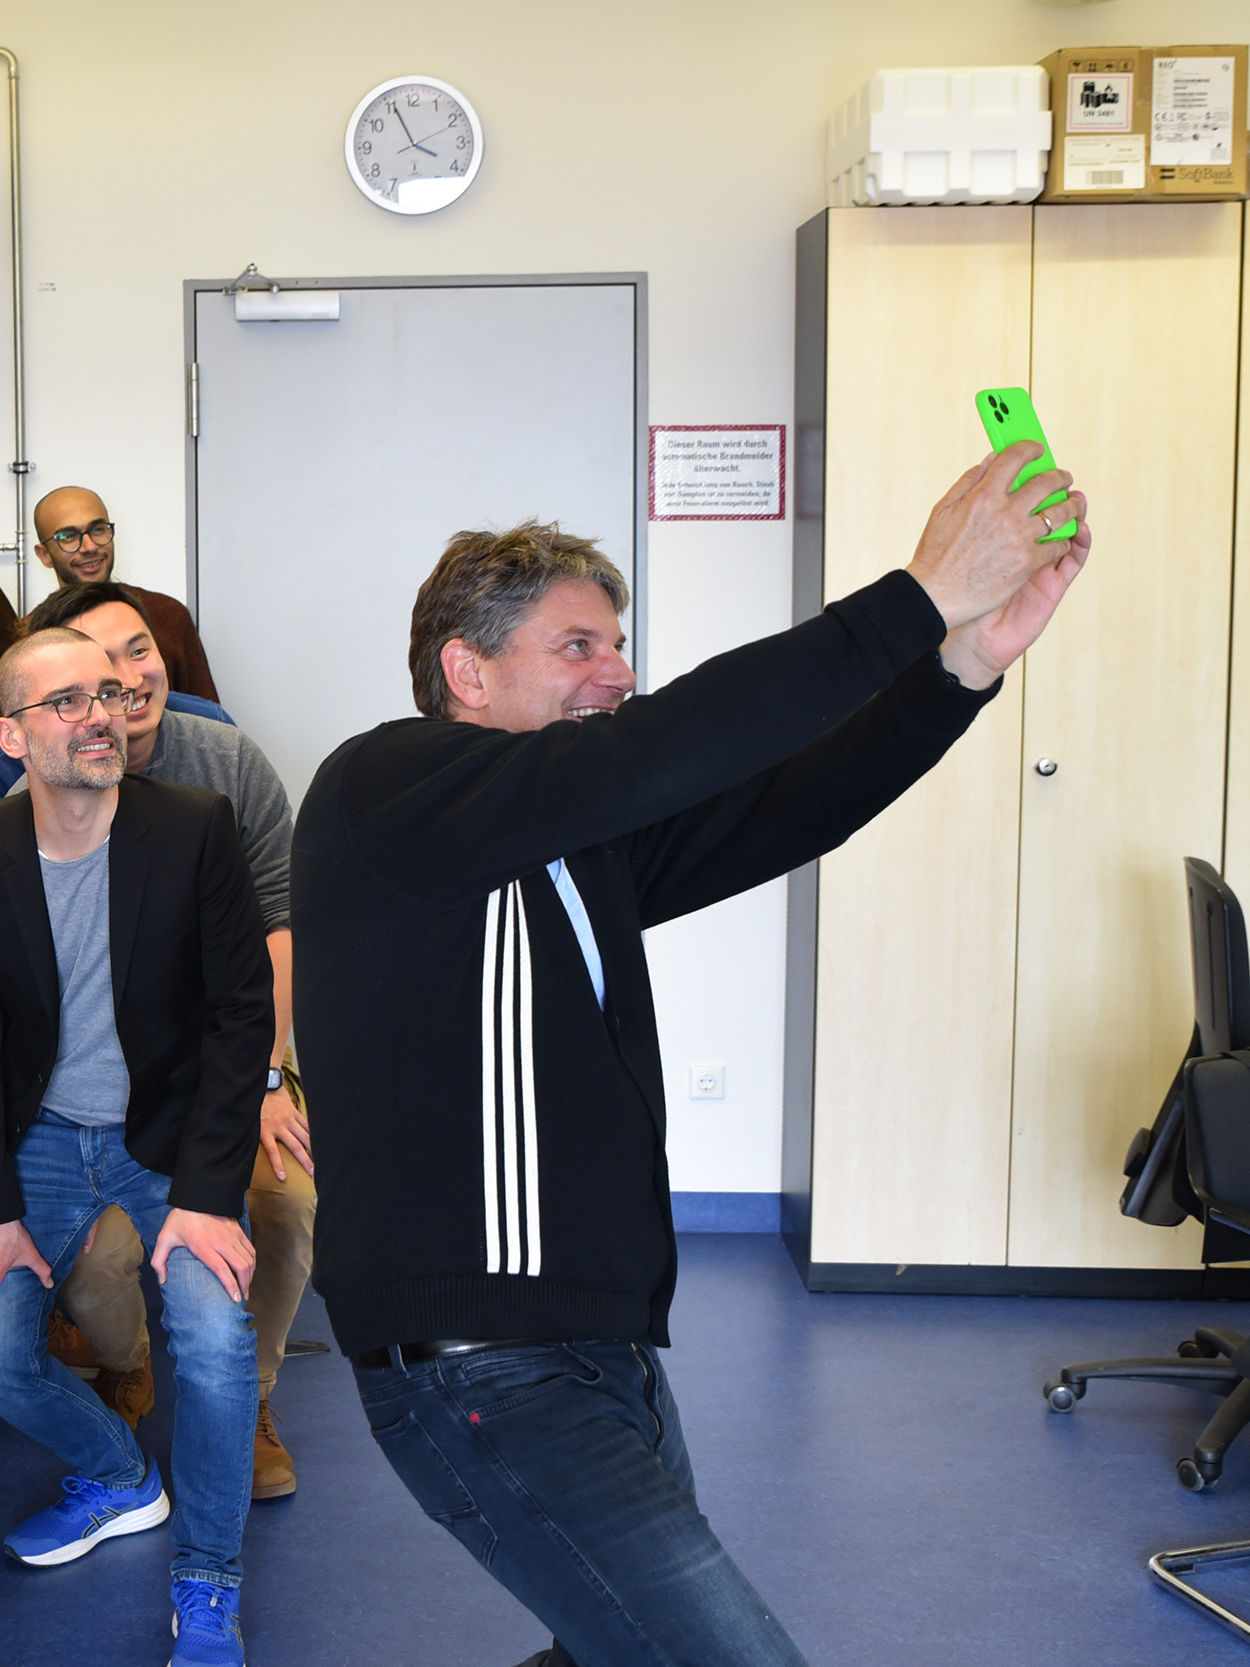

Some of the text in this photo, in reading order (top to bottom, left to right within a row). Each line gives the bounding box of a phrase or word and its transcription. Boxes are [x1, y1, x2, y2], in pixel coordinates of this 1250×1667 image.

[386, 101, 397, 114] 11
[406, 93, 420, 108] 12
[432, 99, 438, 112] 1
[369, 118, 384, 133] 10
[448, 113, 458, 128] 2
[362, 141, 372, 155] 9
[456, 136, 466, 150] 3
[370, 164, 380, 178] 8
[449, 160, 459, 173] 4
[1179, 168, 1233, 182] SoftBank
[389, 178, 398, 192] 7
[697, 440, 720, 448] Raum
[722, 440, 741, 448] wird
[744, 440, 768, 448] durch
[720, 452, 773, 460] Brandmelder
